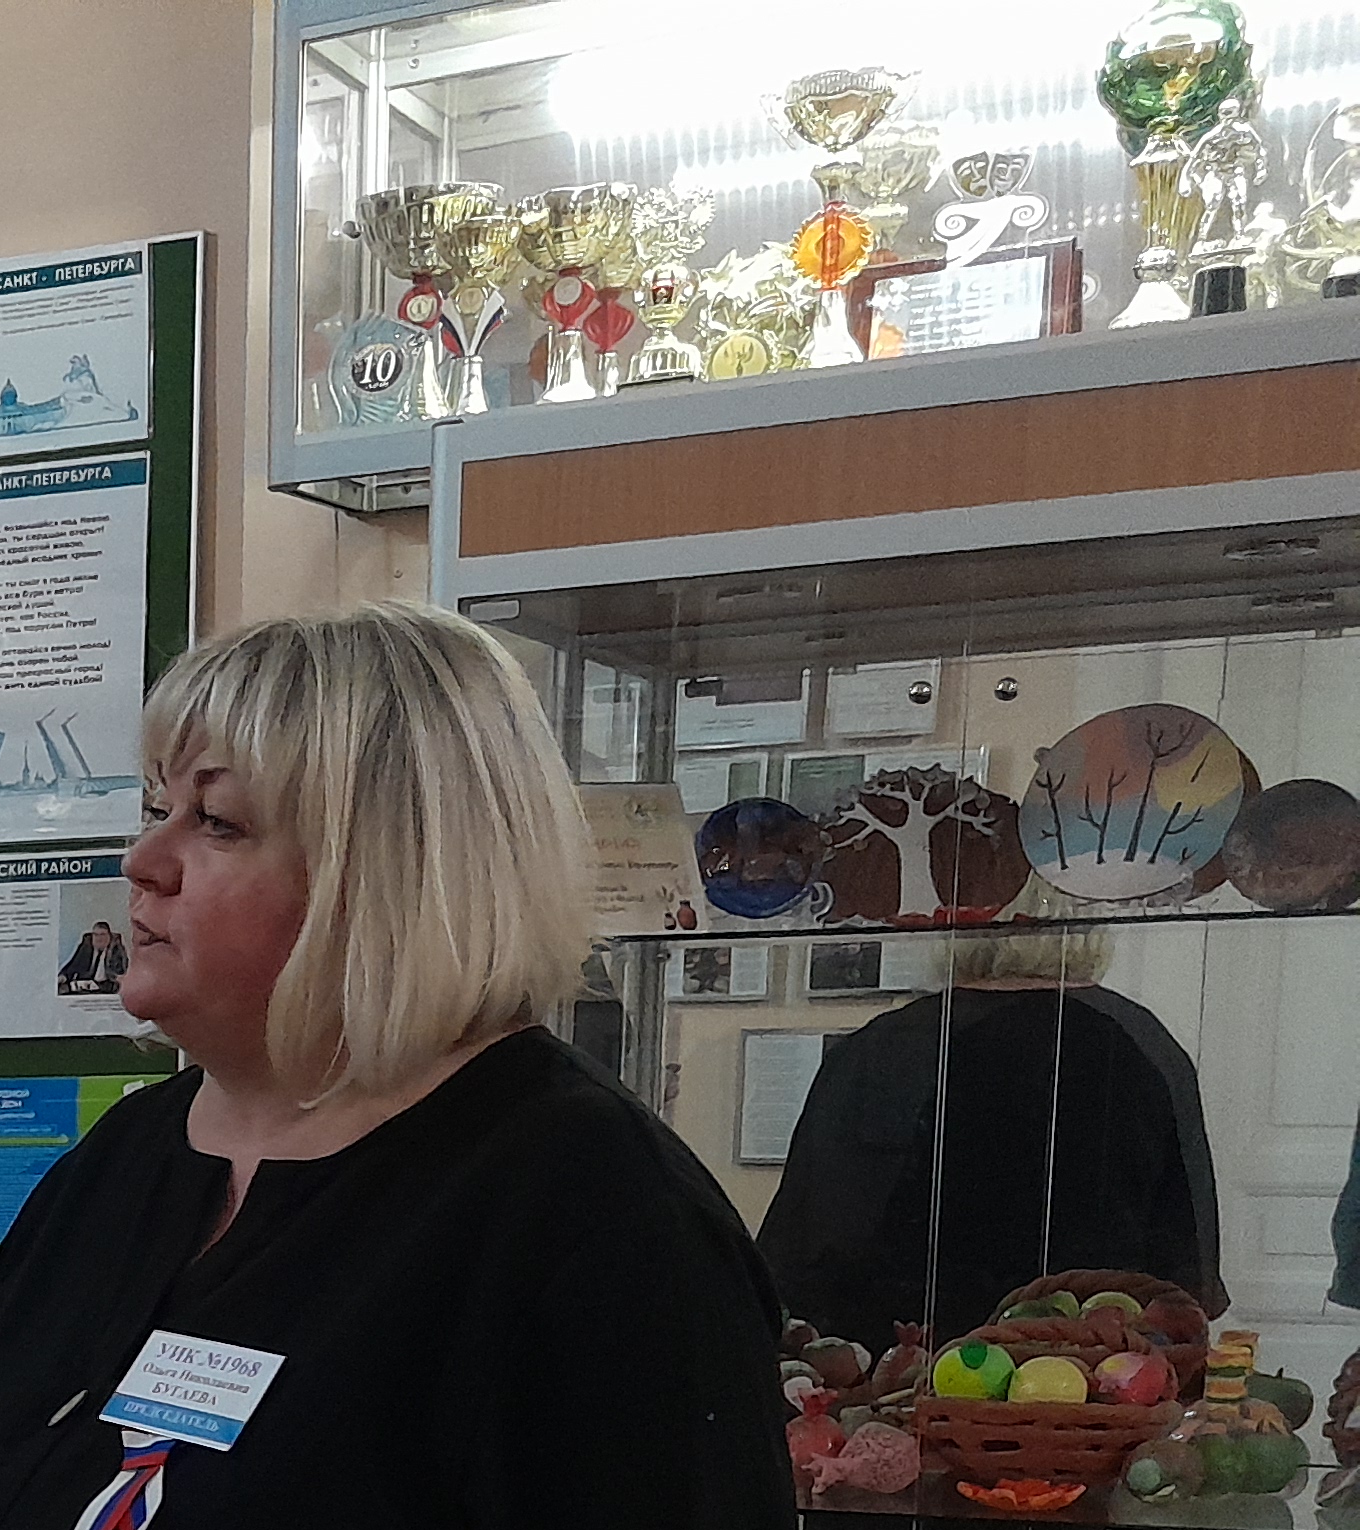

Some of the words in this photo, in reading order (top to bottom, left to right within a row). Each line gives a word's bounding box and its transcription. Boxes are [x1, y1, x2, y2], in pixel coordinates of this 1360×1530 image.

[55, 258, 135, 281] ПЕТЕРБУРГА
[360, 350, 396, 384] 10
[41, 858, 92, 874] РАЙОН
